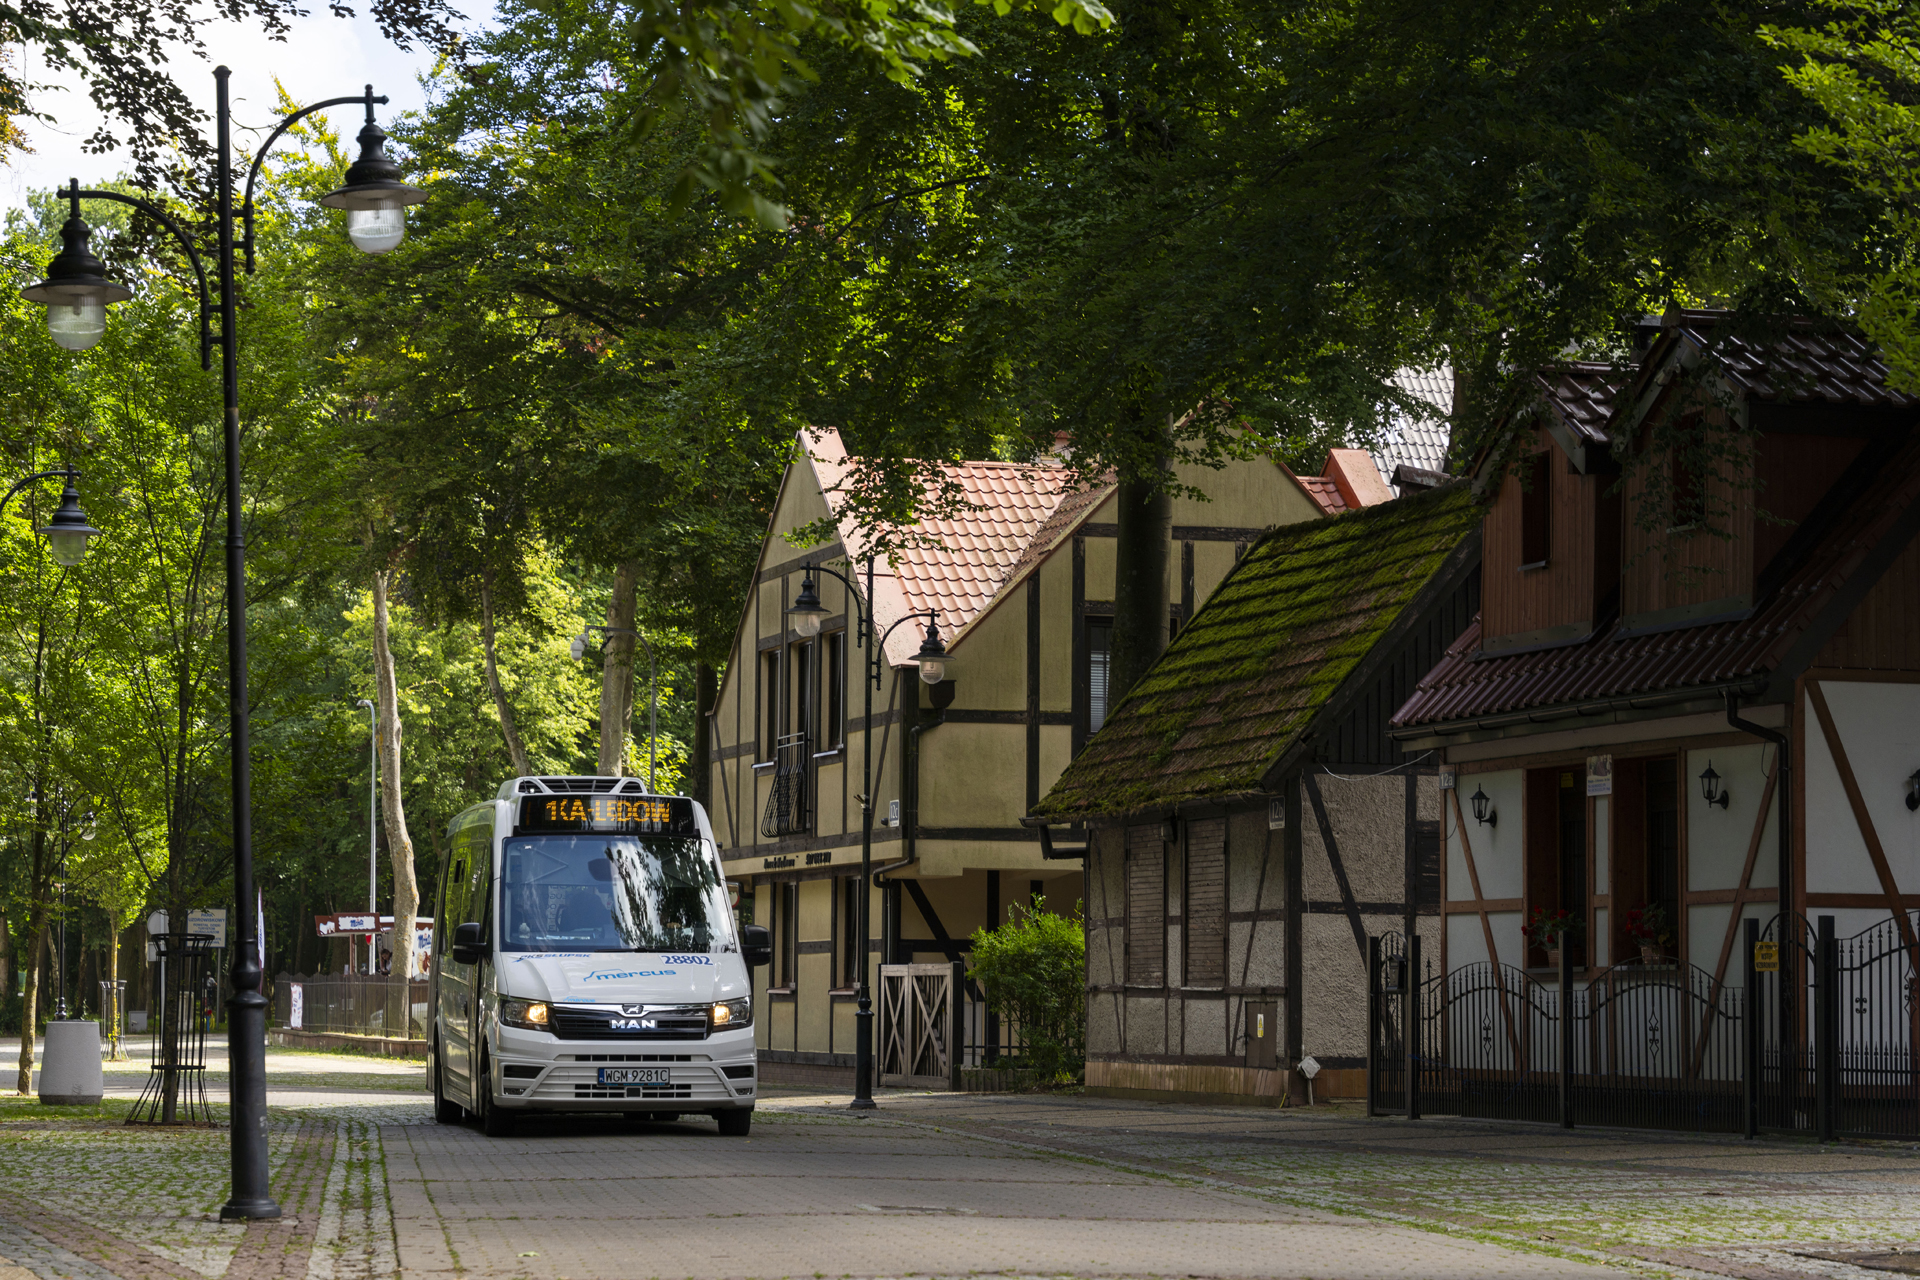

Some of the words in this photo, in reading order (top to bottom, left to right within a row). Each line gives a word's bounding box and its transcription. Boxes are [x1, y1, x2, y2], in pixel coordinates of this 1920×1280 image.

[1440, 773, 1453, 787] 12a
[890, 804, 898, 819] 12c
[660, 955, 714, 966] 28802
[596, 969, 677, 981] mercus
[611, 1019, 655, 1029] MAN
[605, 1070, 628, 1082] WGM
[631, 1069, 667, 1082] 9281C
